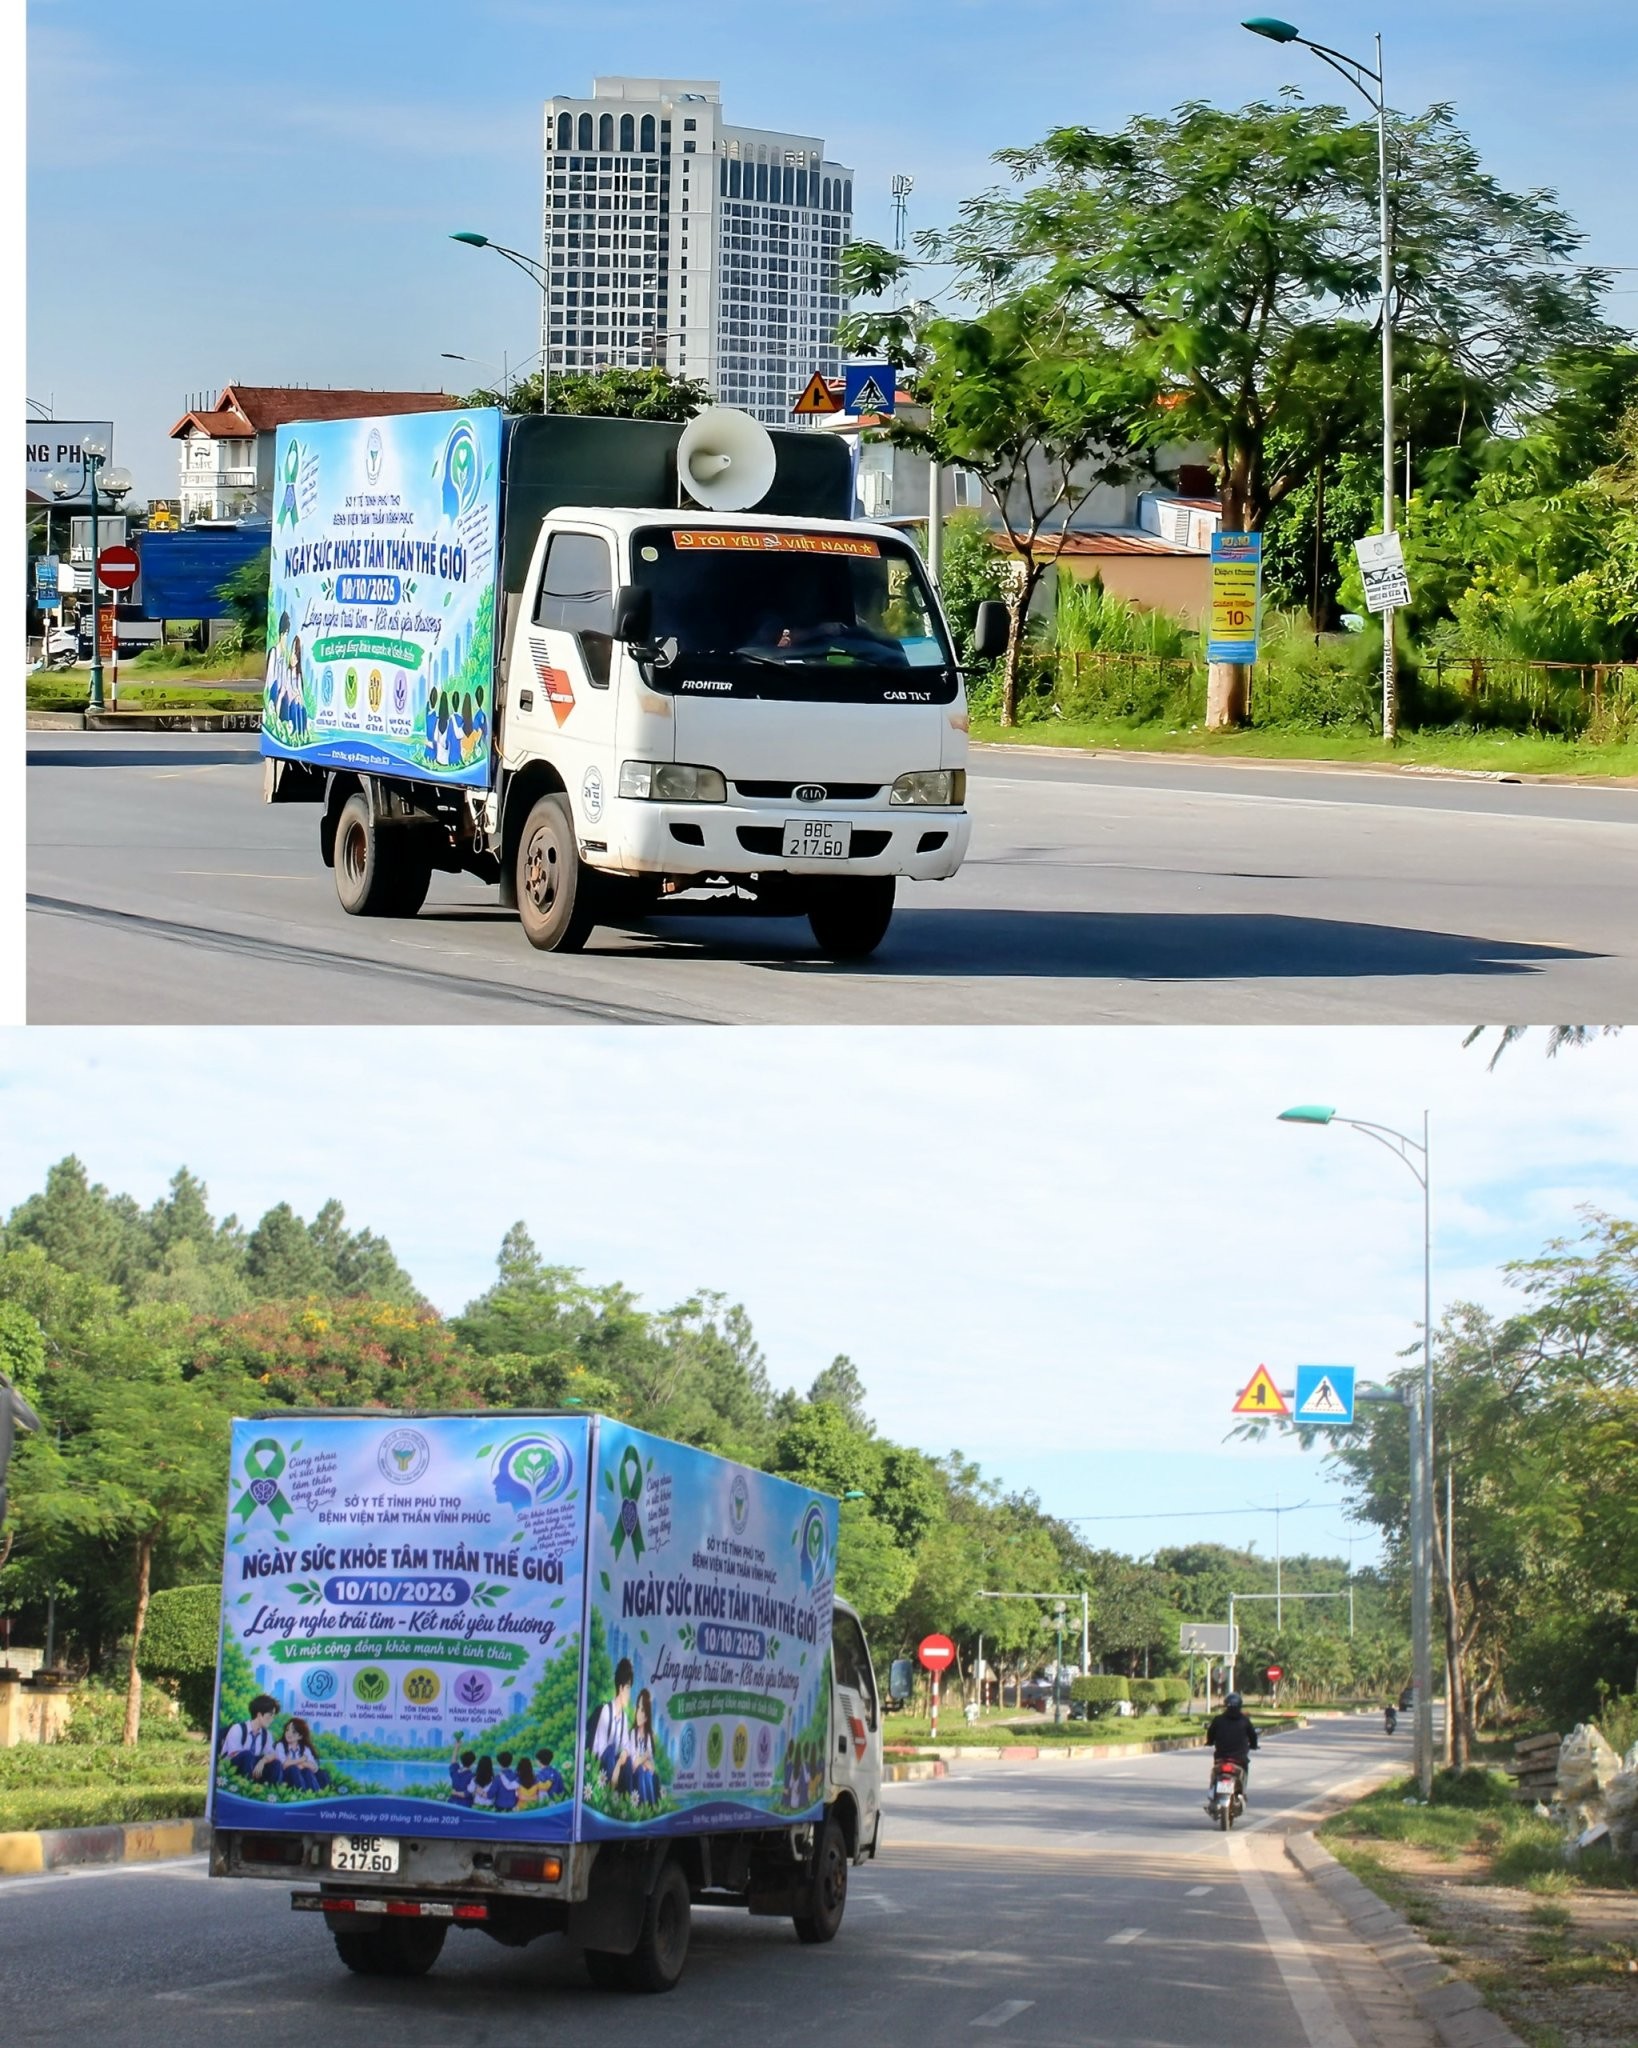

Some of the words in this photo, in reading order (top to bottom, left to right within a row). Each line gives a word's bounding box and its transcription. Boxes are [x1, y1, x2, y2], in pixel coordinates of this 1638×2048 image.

[821, 540, 858, 553] NAM
[804, 822, 833, 838] 88C
[790, 839, 843, 856] 217.60
[344, 1494, 359, 1507] SỞ
[362, 1498, 369, 1507] Y
[373, 1493, 385, 1507] TẾ
[387, 1493, 412, 1507] TỈNH
[414, 1494, 437, 1507] PHÚ
[439, 1497, 461, 1510] THỌ
[319, 1511, 347, 1526] BỆNH
[349, 1510, 375, 1526] VIỆN
[377, 1510, 399, 1523] TÂM
[434, 1510, 459, 1523] VĨNH
[461, 1509, 491, 1523] PHÚC
[242, 1547, 297, 1580] NGÀY
[301, 1543, 336, 1572] SỨC
[340, 1543, 387, 1569] KHỎE
[391, 1543, 428, 1569] TÂM
[432, 1542, 479, 1572] THẦN
[483, 1547, 520, 1577] THẾ
[522, 1553, 563, 1585] GIỚI
[335, 1580, 457, 1602] 10/10/2026
[622, 1571, 666, 1618] NGÀY
[666, 1573, 692, 1618] SỨC
[694, 1578, 726, 1619] KHỎE
[728, 1584, 750, 1621] TÂM
[752, 1586, 778, 1629] THẦN
[779, 1596, 796, 1635] THẾ
[797, 1604, 818, 1646] GIỚI
[243, 1605, 296, 1638] Lắng
[300, 1609, 337, 1638] nghe
[339, 1611, 367, 1629] trái
[370, 1611, 395, 1629] tim
[408, 1609, 438, 1633] Kết
[439, 1610, 466, 1631] nối
[464, 1614, 495, 1640] yêu
[497, 1612, 556, 1644] thương
[299, 1642, 322, 1657] một
[324, 1642, 351, 1658] cộng
[413, 1642, 445, 1657] mạnh
[462, 1645, 484, 1658] tinh
[704, 1627, 761, 1657] 10/10/2026
[681, 1656, 701, 1692] nghe
[720, 1661, 733, 1684] tim
[360, 1813, 378, 1822] ngày
[391, 1814, 411, 1824] tháng
[441, 1816, 460, 1824] 2026
[351, 1837, 380, 1852] 88C
[338, 1852, 392, 1871] 217.60
